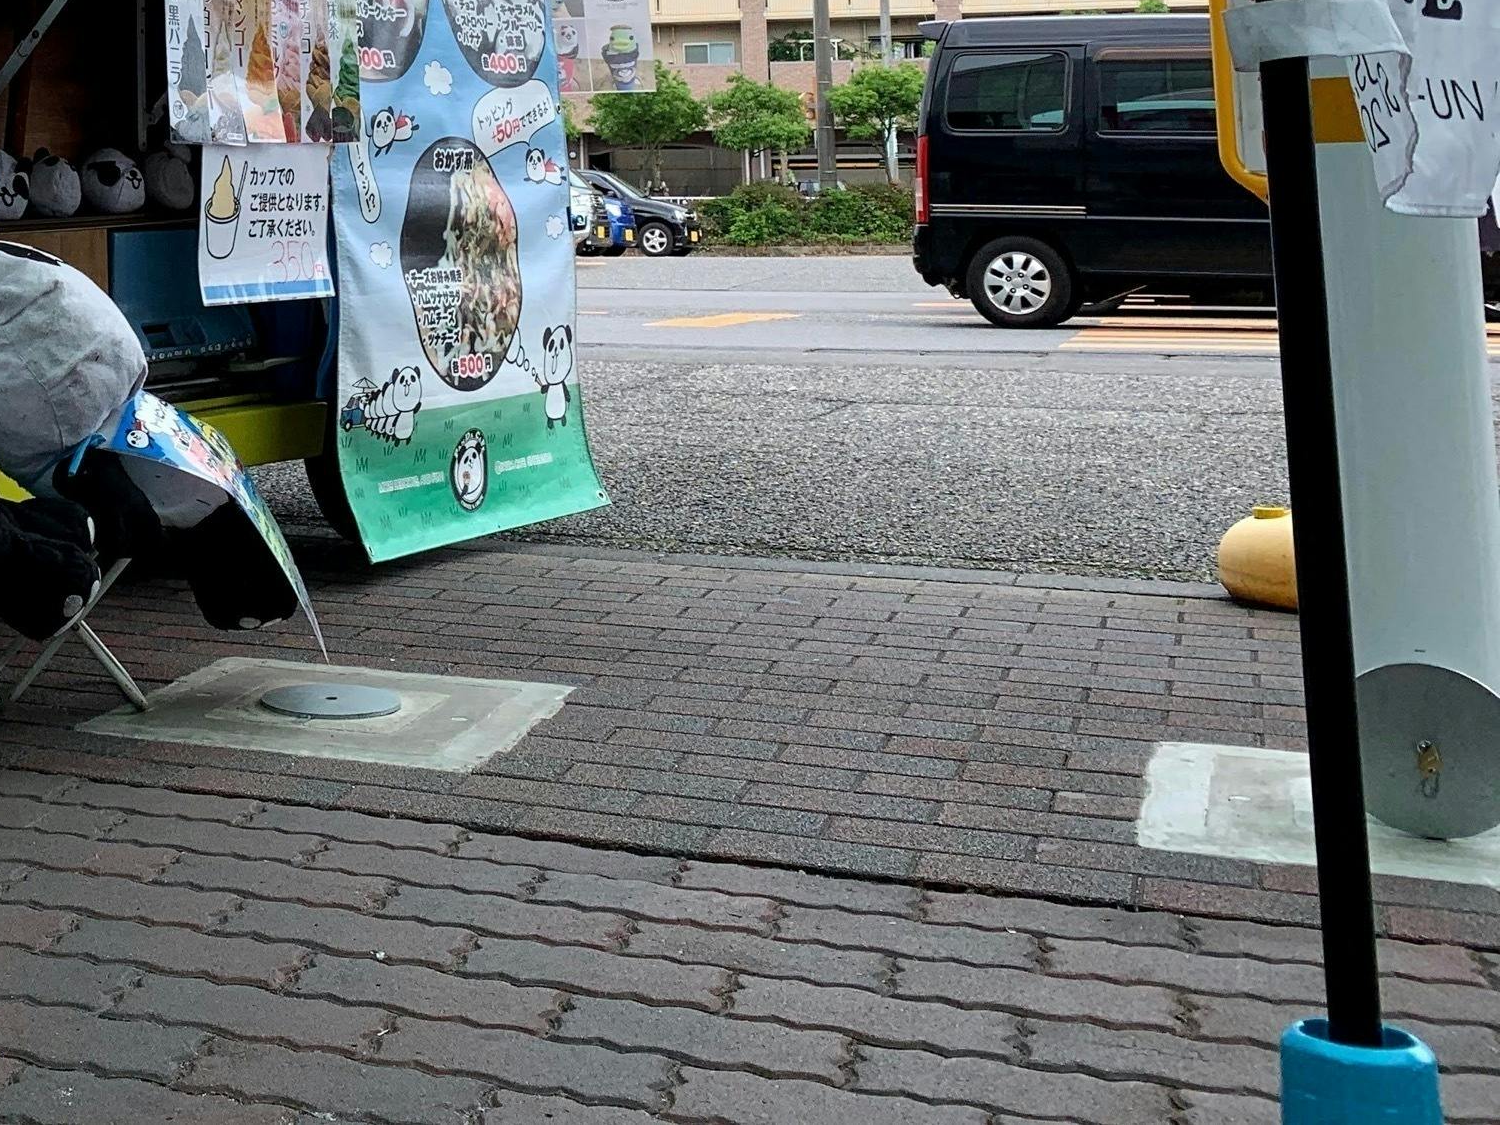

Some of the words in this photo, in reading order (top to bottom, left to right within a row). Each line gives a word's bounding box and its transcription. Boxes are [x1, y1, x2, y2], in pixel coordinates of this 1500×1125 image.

[1417, 77, 1485, 122] UN
[477, 98, 513, 130] トッピング
[250, 167, 295, 186] カップでの
[250, 192, 326, 212] ご提供となります。
[248, 218, 316, 238] ご了承ください。
[422, 309, 456, 327] ハムチーズ
